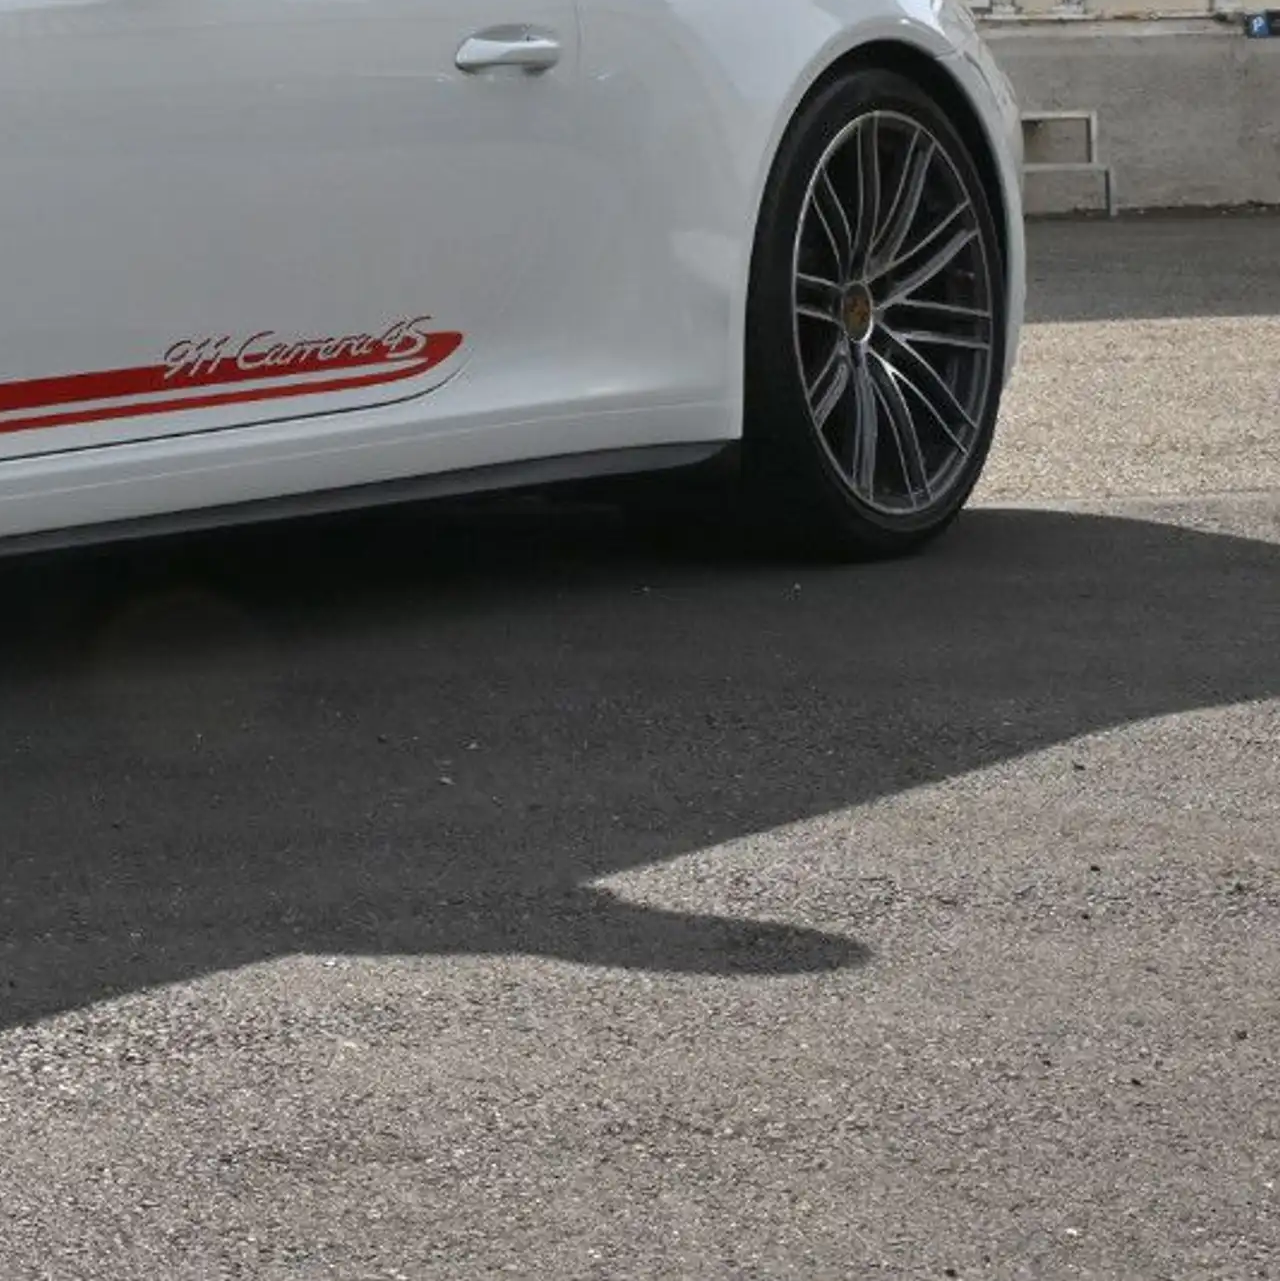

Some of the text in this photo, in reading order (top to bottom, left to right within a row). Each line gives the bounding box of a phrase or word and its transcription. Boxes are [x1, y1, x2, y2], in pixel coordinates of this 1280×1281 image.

[163, 316, 432, 380] 911 Carrera 4S
